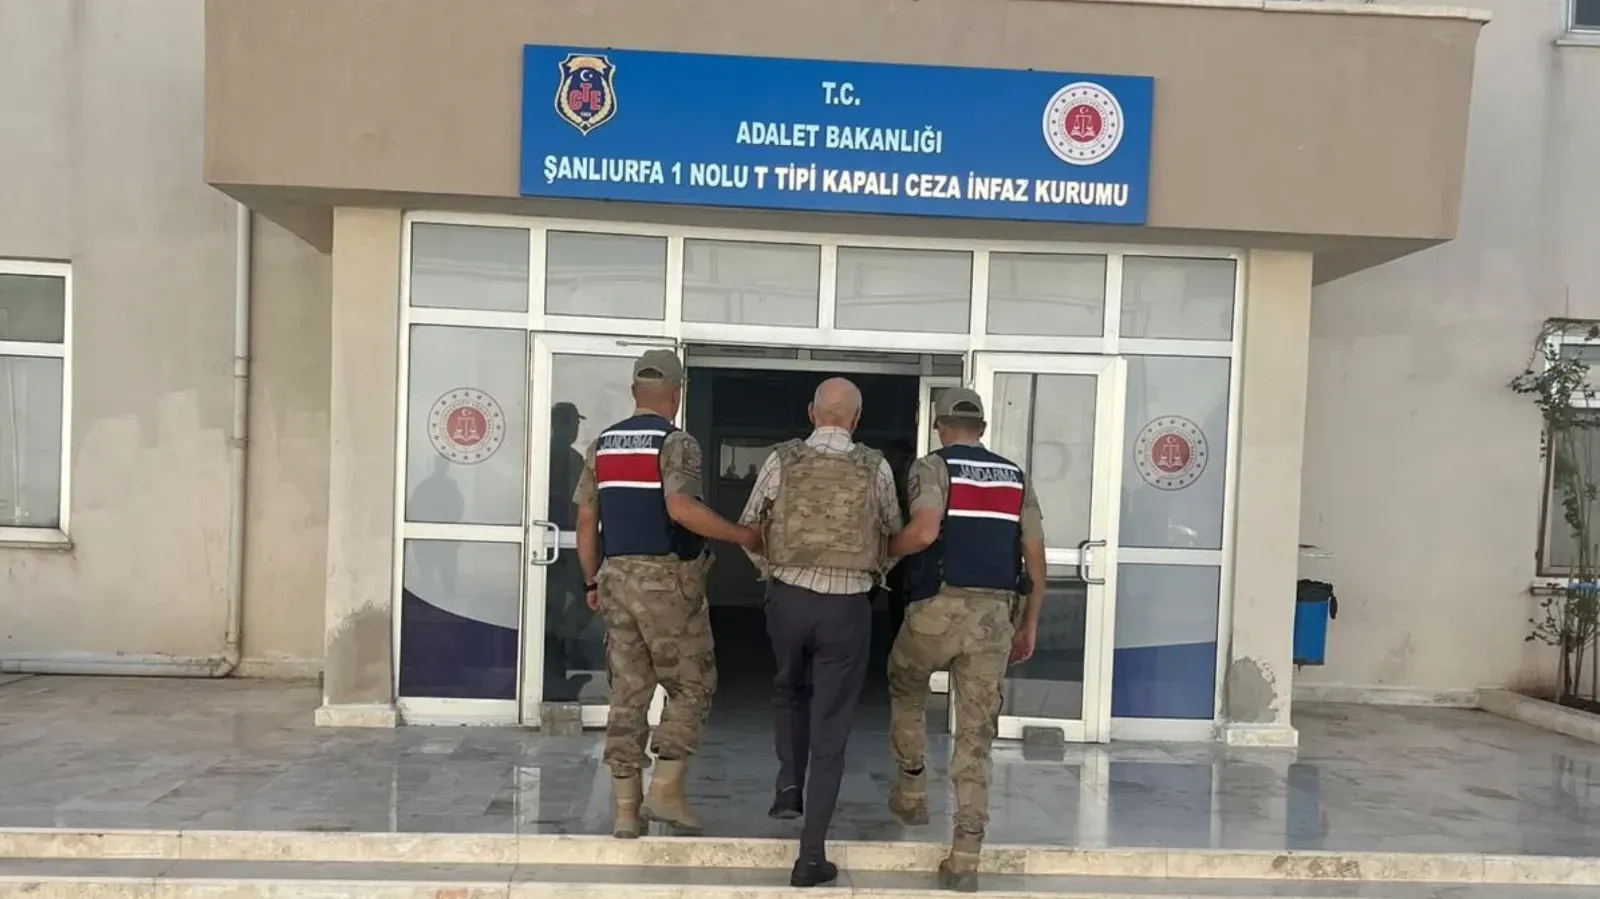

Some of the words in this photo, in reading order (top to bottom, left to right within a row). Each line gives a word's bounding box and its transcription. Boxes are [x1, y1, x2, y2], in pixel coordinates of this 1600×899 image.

[822, 81, 860, 106] T.C.
[736, 121, 819, 147] ADALET
[826, 125, 943, 153] BAKANLIĞI
[544, 155, 664, 184] ŞANLIURFA
[671, 162, 681, 185] 1
[690, 163, 748, 188] NOLU
[754, 167, 768, 190] T
[775, 163, 816, 192] TİPİ
[823, 169, 898, 196] KAPALI
[905, 173, 961, 199] CEZA
[968, 171, 1029, 202] İNFAZ
[1035, 180, 1129, 207] KURUMU
[958, 464, 1018, 483] JANDARMA
